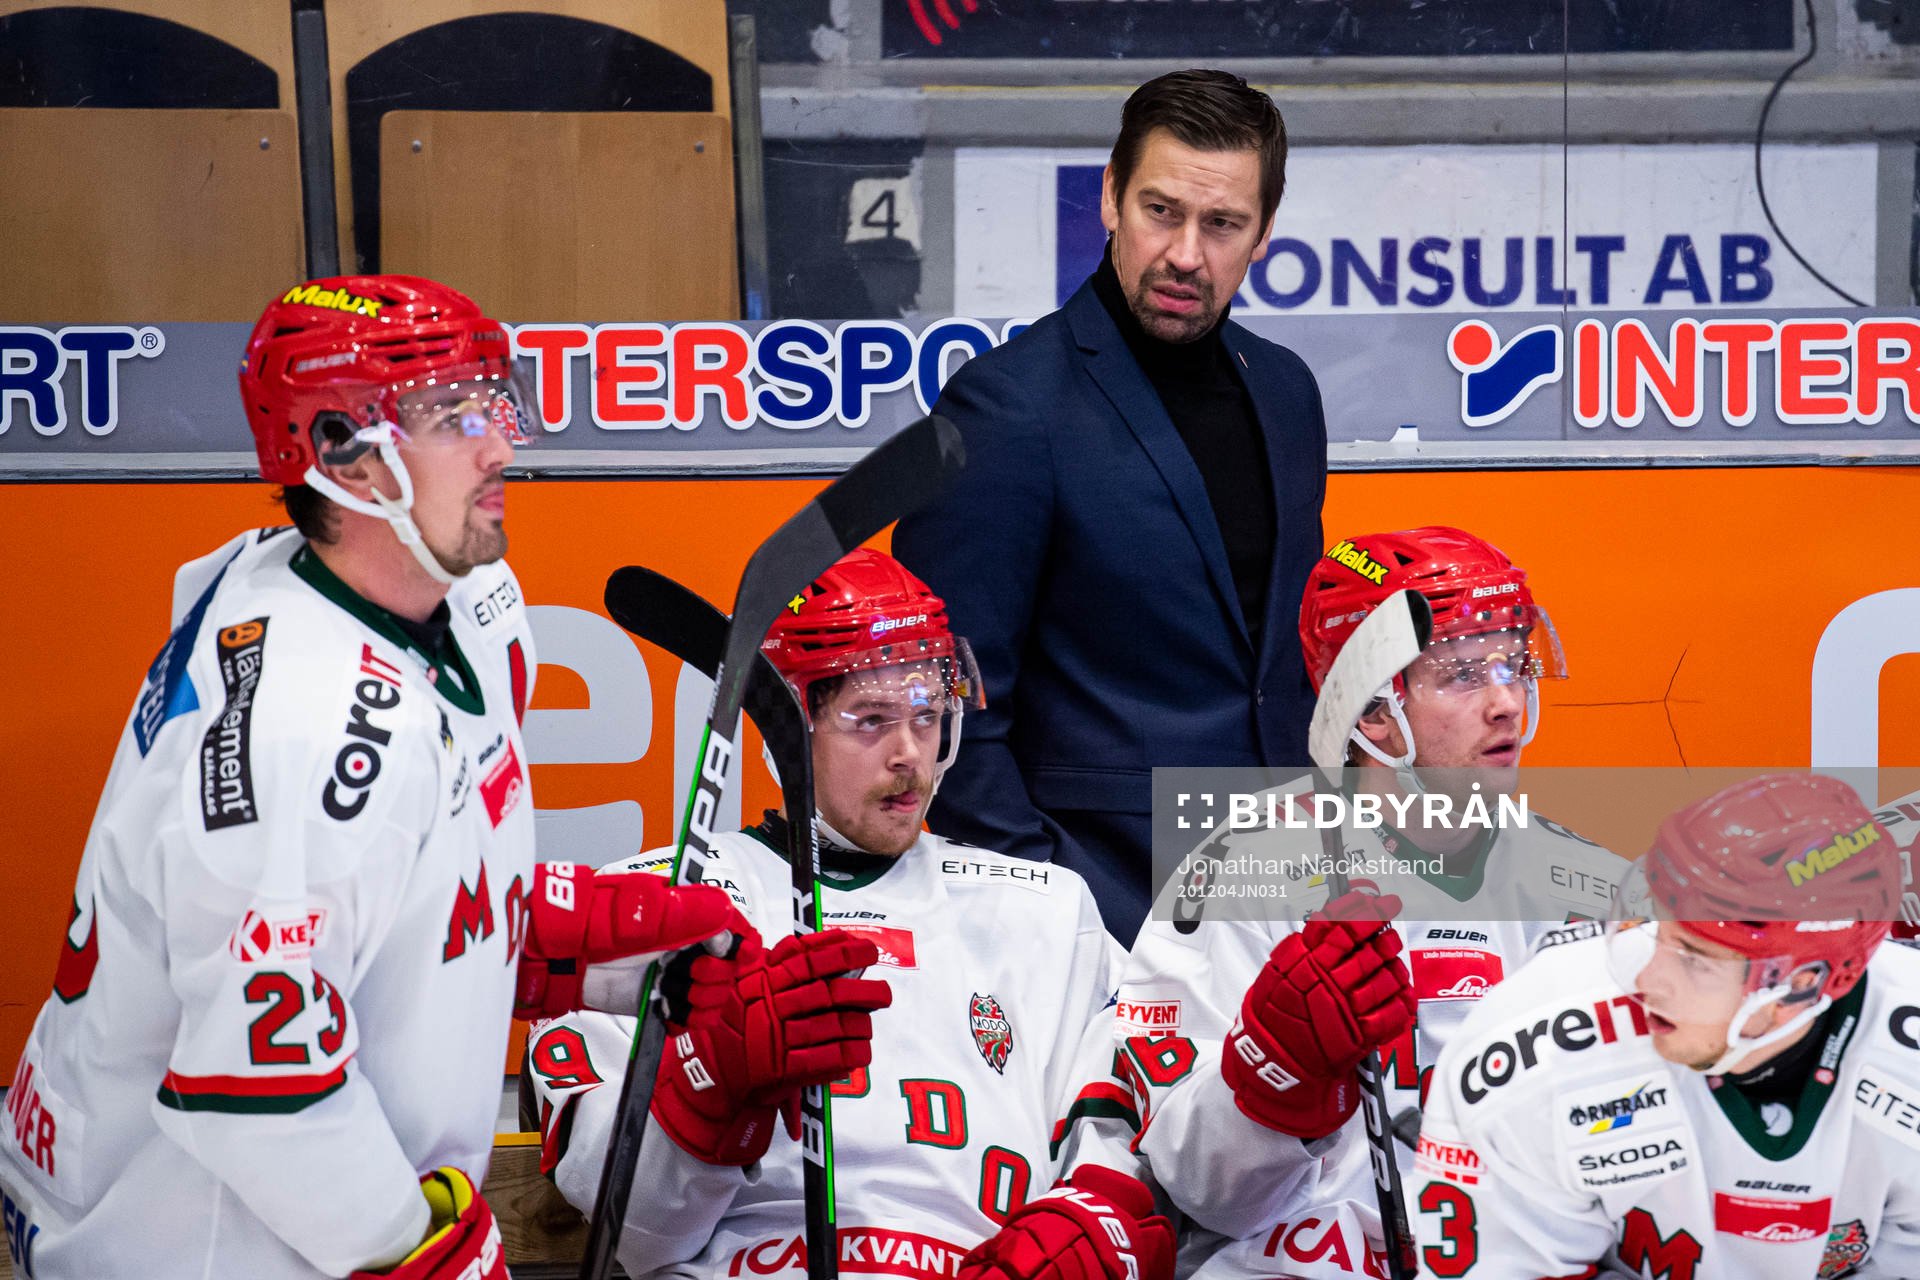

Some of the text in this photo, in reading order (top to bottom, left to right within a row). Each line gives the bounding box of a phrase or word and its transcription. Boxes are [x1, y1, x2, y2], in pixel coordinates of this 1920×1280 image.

[861, 189, 901, 238] 4
[1643, 232, 1775, 304] AB
[282, 284, 383, 318] Malux
[1327, 540, 1389, 585] Malux
[1471, 582, 1520, 599] BAUER
[871, 614, 928, 633] BAUER
[1785, 821, 1882, 888] Malux
[1426, 928, 1488, 945] BAUER
[1460, 992, 1651, 1105] coreIT
[1735, 1179, 1812, 1194] BAUER
[841, 1234, 966, 1280] KVANT
[1263, 1217, 1355, 1273] ICA
